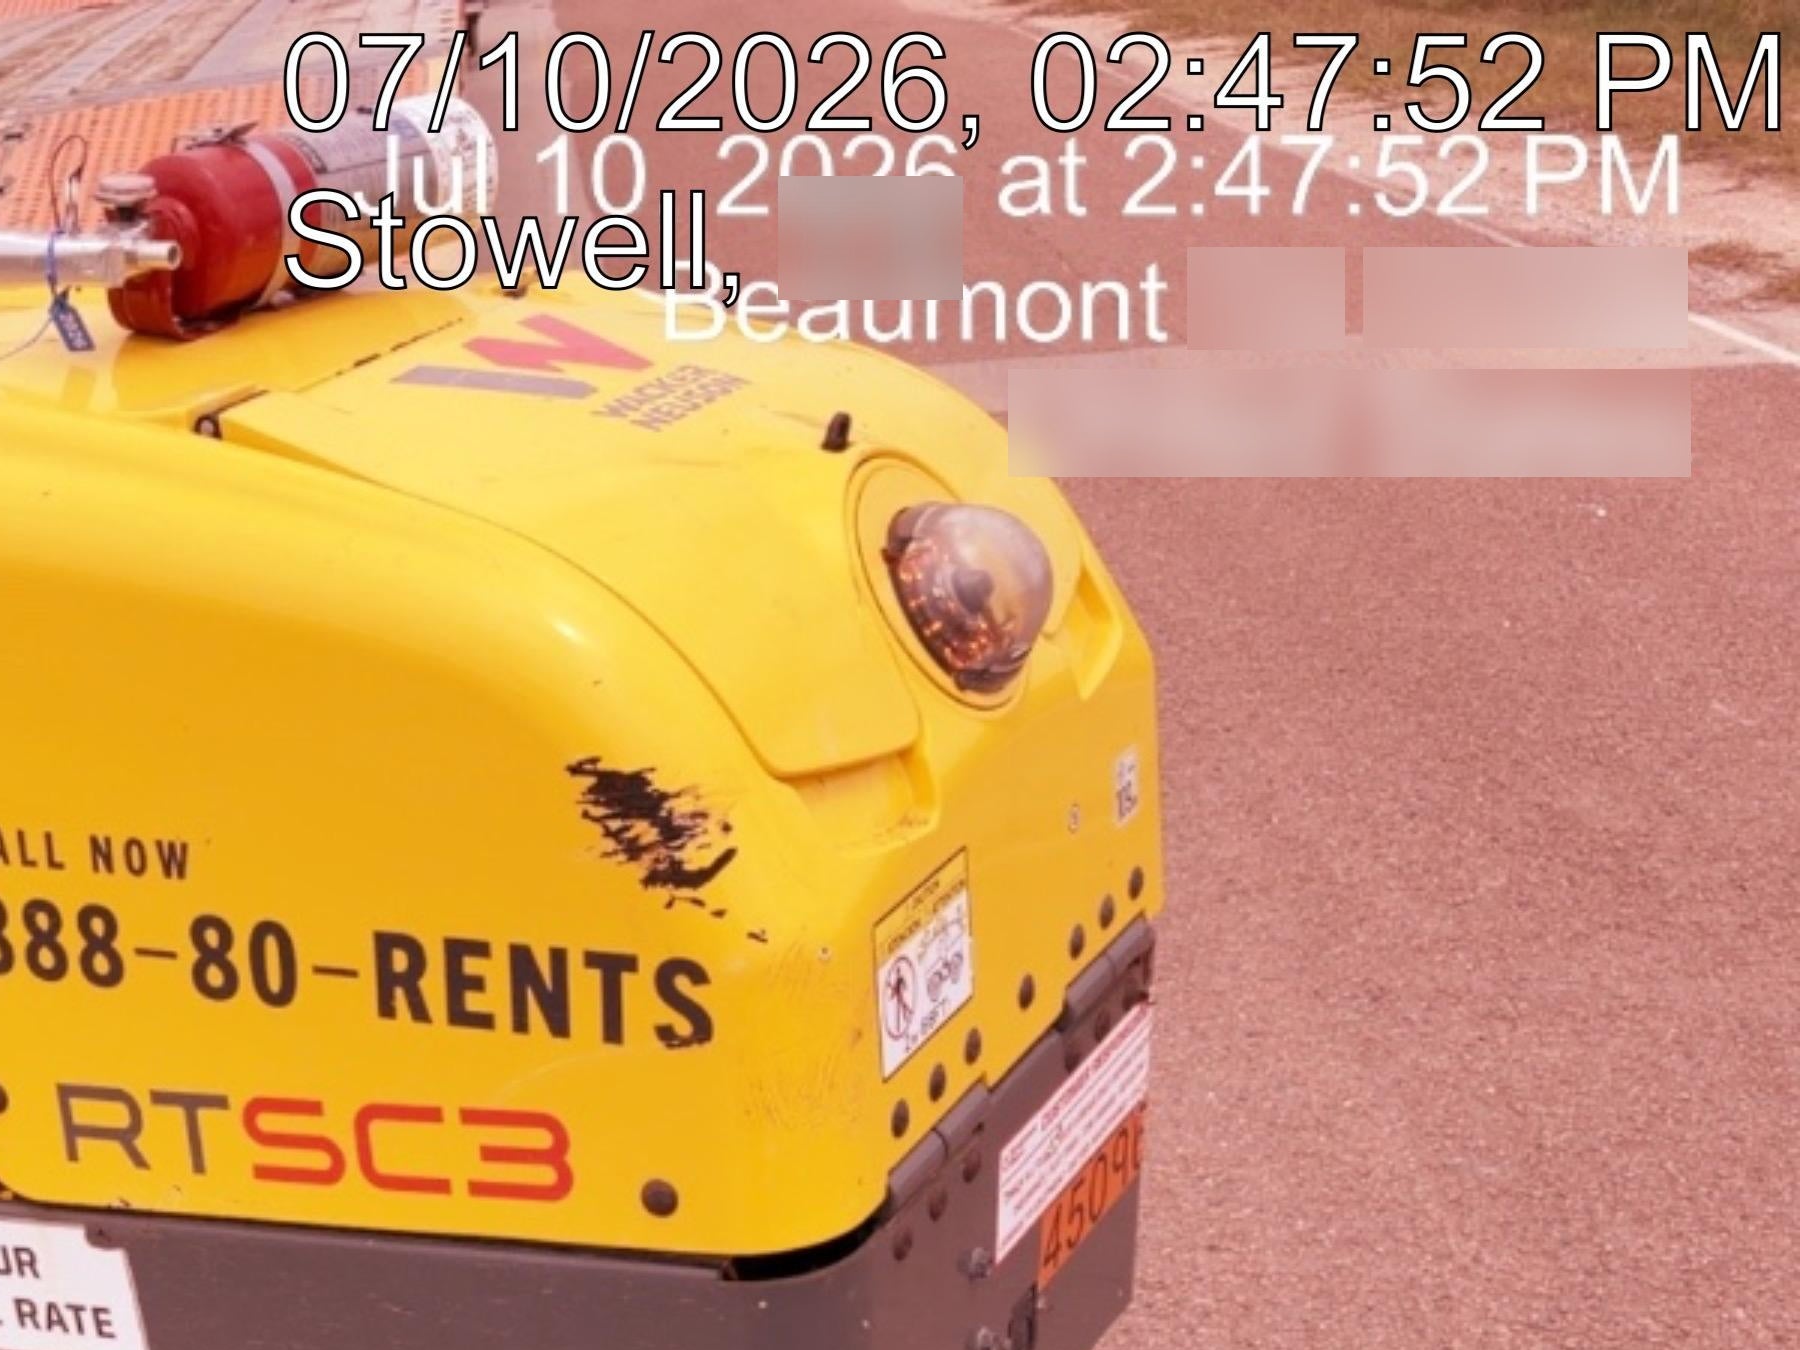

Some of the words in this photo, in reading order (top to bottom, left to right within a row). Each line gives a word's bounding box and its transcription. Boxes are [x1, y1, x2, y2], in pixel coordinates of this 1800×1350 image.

[91, 832, 190, 881] NOW
[55, 1082, 575, 1203] RTSC3
[13, 1297, 119, 1340] RATE
